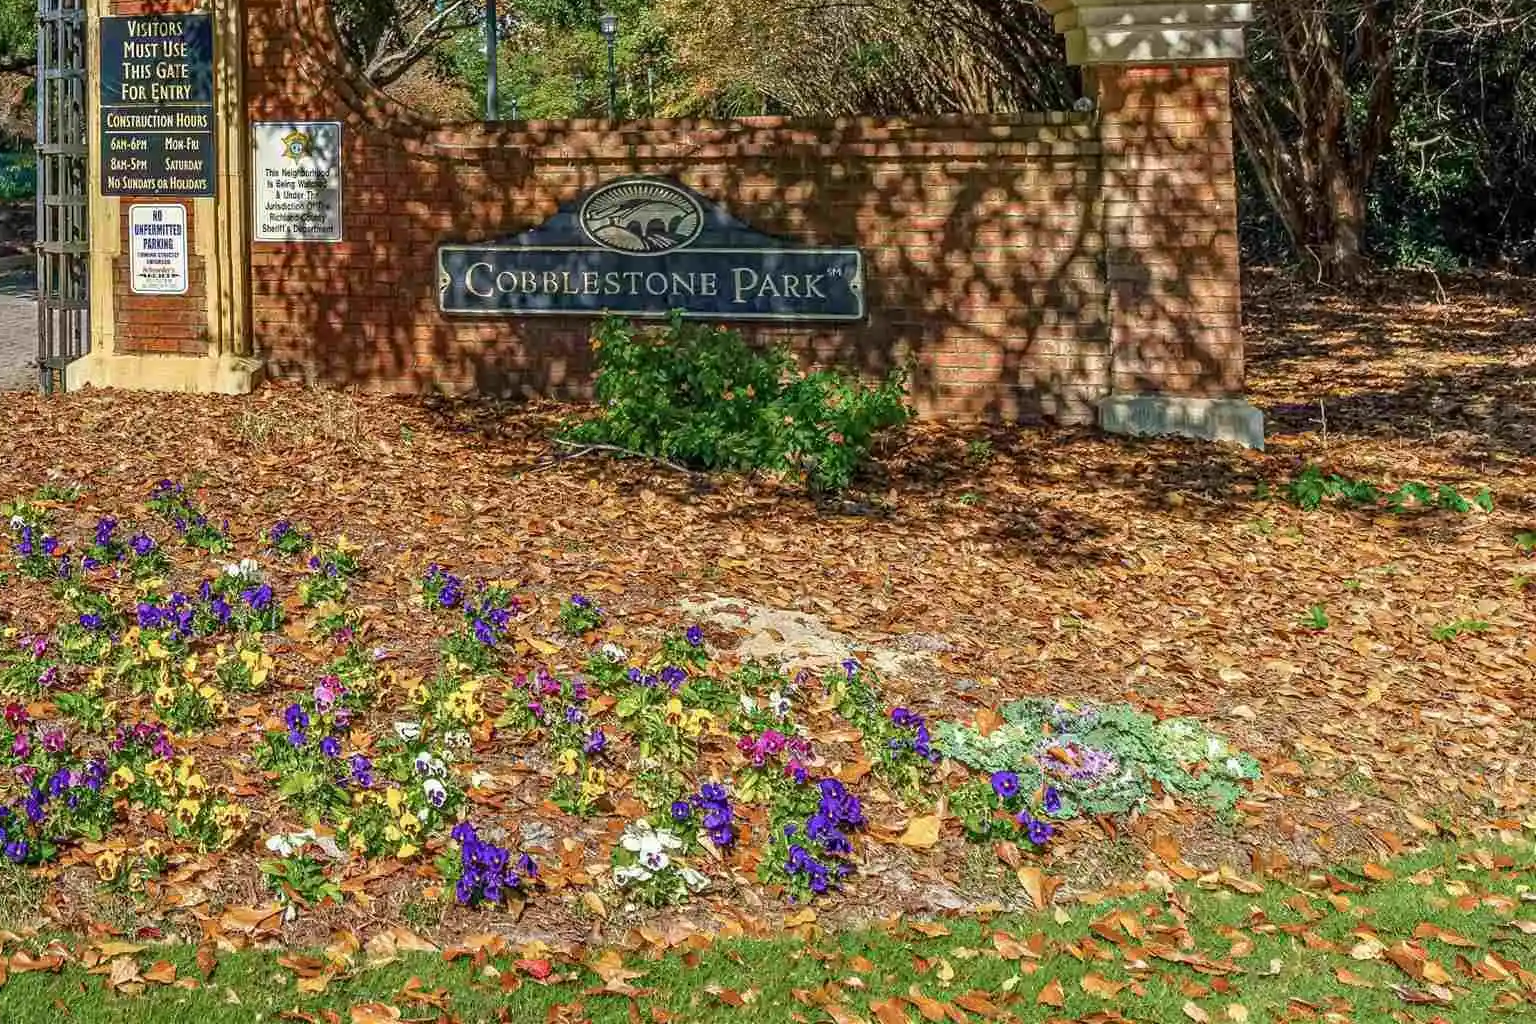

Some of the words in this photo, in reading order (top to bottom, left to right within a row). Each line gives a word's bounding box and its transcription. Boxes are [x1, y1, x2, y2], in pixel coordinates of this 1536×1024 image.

[128, 20, 184, 37] VISITORS
[124, 41, 158, 58] MUST
[163, 41, 189, 57] USE
[122, 62, 152, 79] THIS
[156, 62, 189, 79] GATE
[121, 83, 146, 101] FOR
[151, 82, 192, 100] ENTRY
[107, 113, 174, 128] CONSTRUCTION
[175, 112, 208, 128] HOURS
[110, 137, 147, 150] 6AM-6PM
[164, 137, 200, 150] MON-FRI
[110, 157, 147, 170] 8AM-5PM
[165, 157, 203, 171] SATURDAY
[107, 176, 121, 189] NO
[123, 176, 156, 189] SUNDAYS
[157, 179, 168, 189] OR
[170, 176, 208, 190] HOLIDAYS
[153, 210, 163, 222] NO
[143, 238, 174, 249] PARKING
[464, 262, 717, 297] COBBLESTONE
[732, 267, 826, 304] PARK
